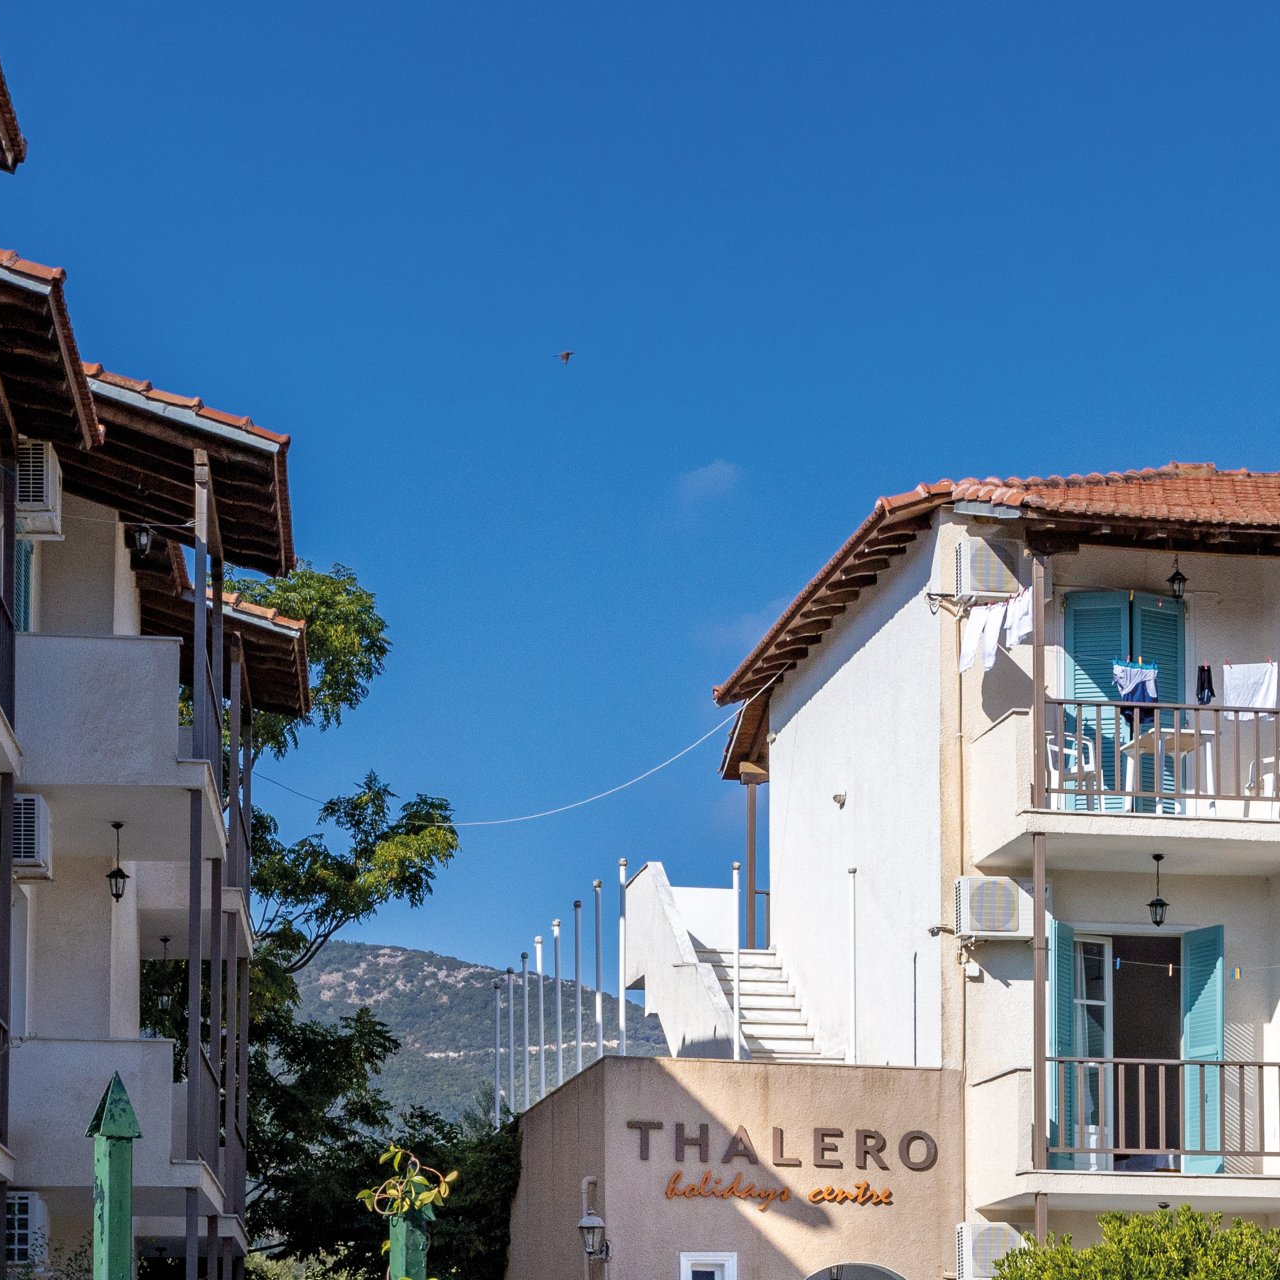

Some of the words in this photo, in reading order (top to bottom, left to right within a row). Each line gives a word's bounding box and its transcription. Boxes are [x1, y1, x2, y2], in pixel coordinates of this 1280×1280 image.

[626, 1121, 939, 1172] THALERO
[665, 1170, 791, 1212] holidays
[807, 1181, 894, 1206] centre
